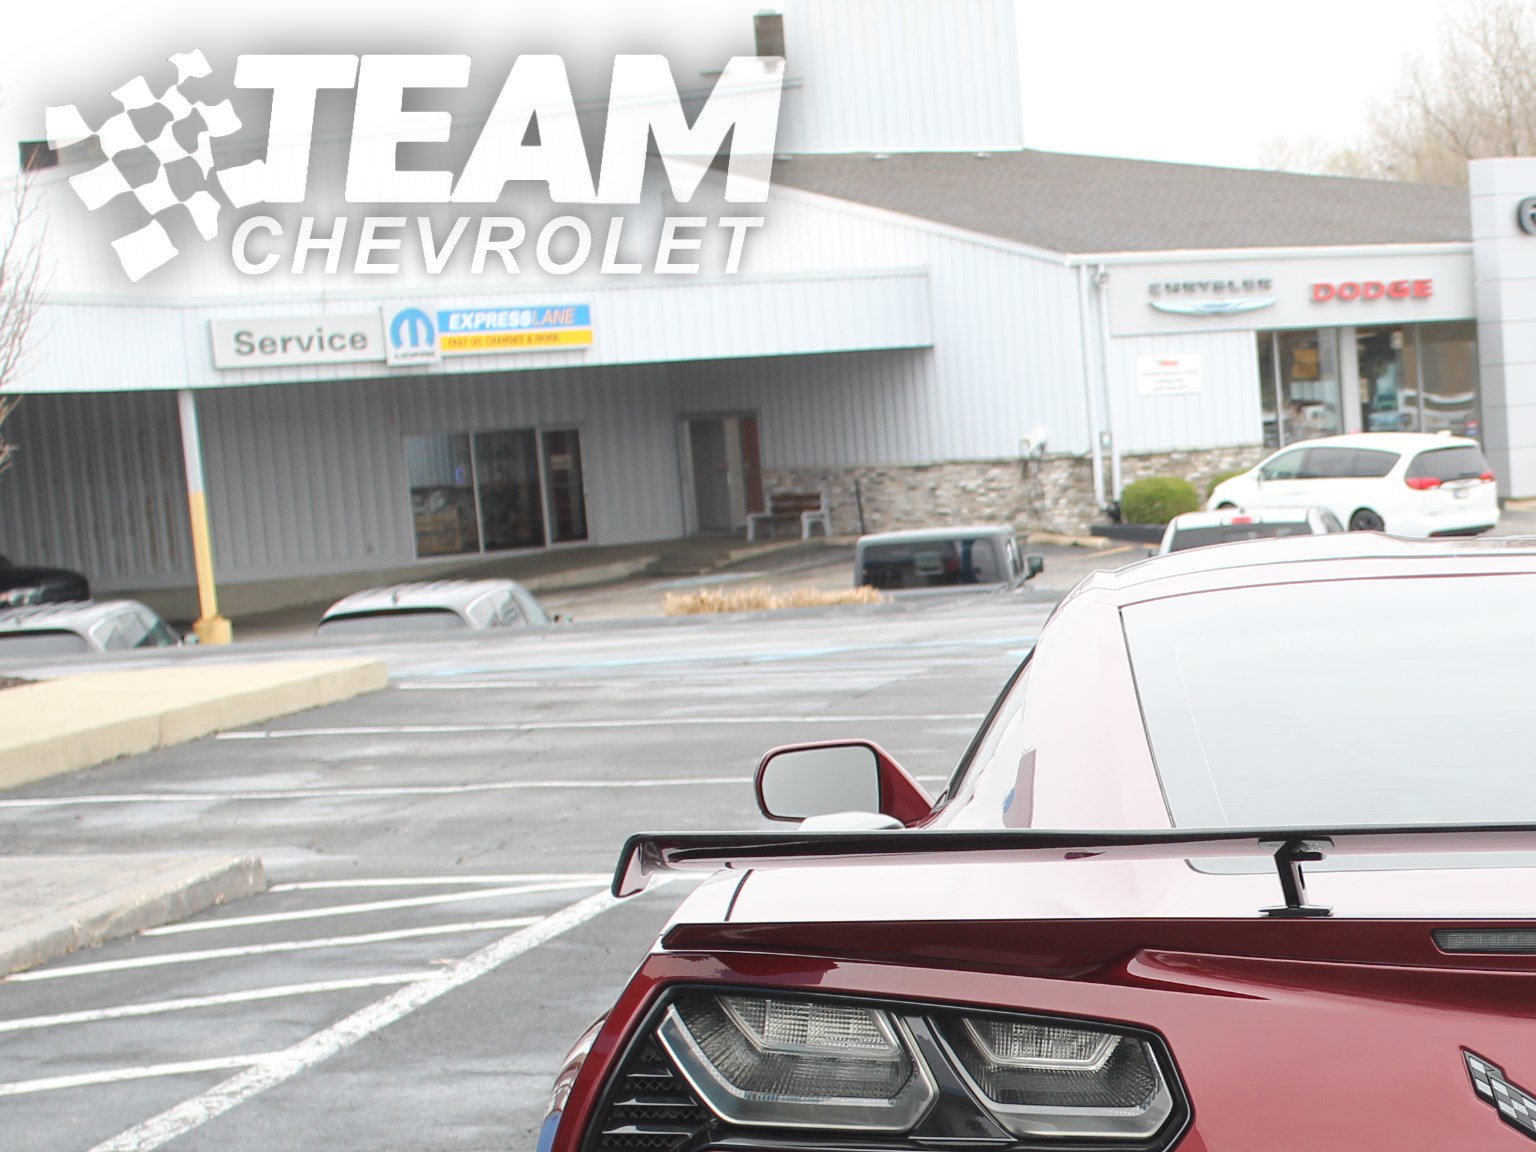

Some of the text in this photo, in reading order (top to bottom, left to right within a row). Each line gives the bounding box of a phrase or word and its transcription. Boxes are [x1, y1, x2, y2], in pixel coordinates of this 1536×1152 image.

[1149, 278, 1273, 296] CHRYSLER
[1310, 279, 1434, 303] DODGE
[233, 327, 368, 356] Service
[535, 334, 560, 343] MORE
